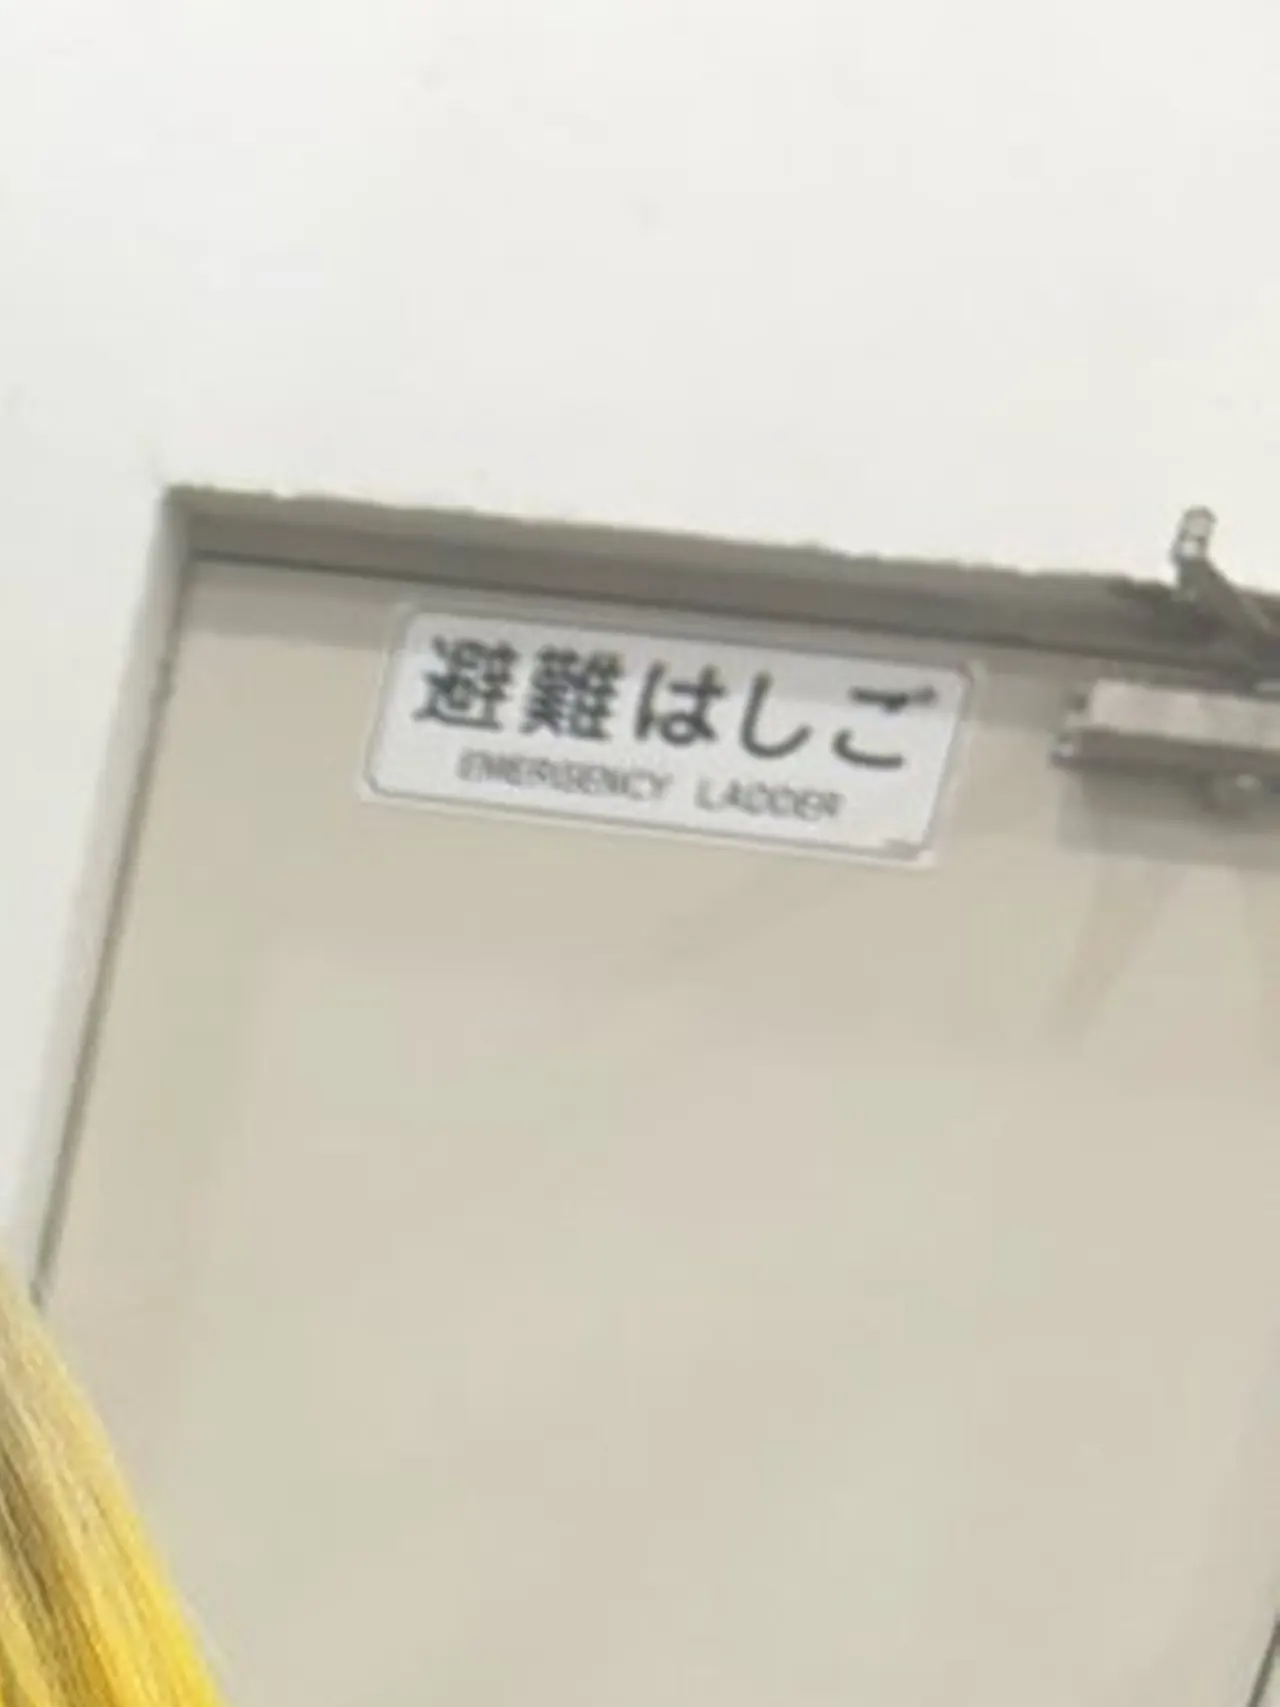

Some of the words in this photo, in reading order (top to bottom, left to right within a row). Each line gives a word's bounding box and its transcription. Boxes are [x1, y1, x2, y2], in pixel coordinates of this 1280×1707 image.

[414, 636, 939, 770] 避難はしご
[456, 749, 673, 801] EMERGENCY
[694, 777, 847, 822] LADDER
